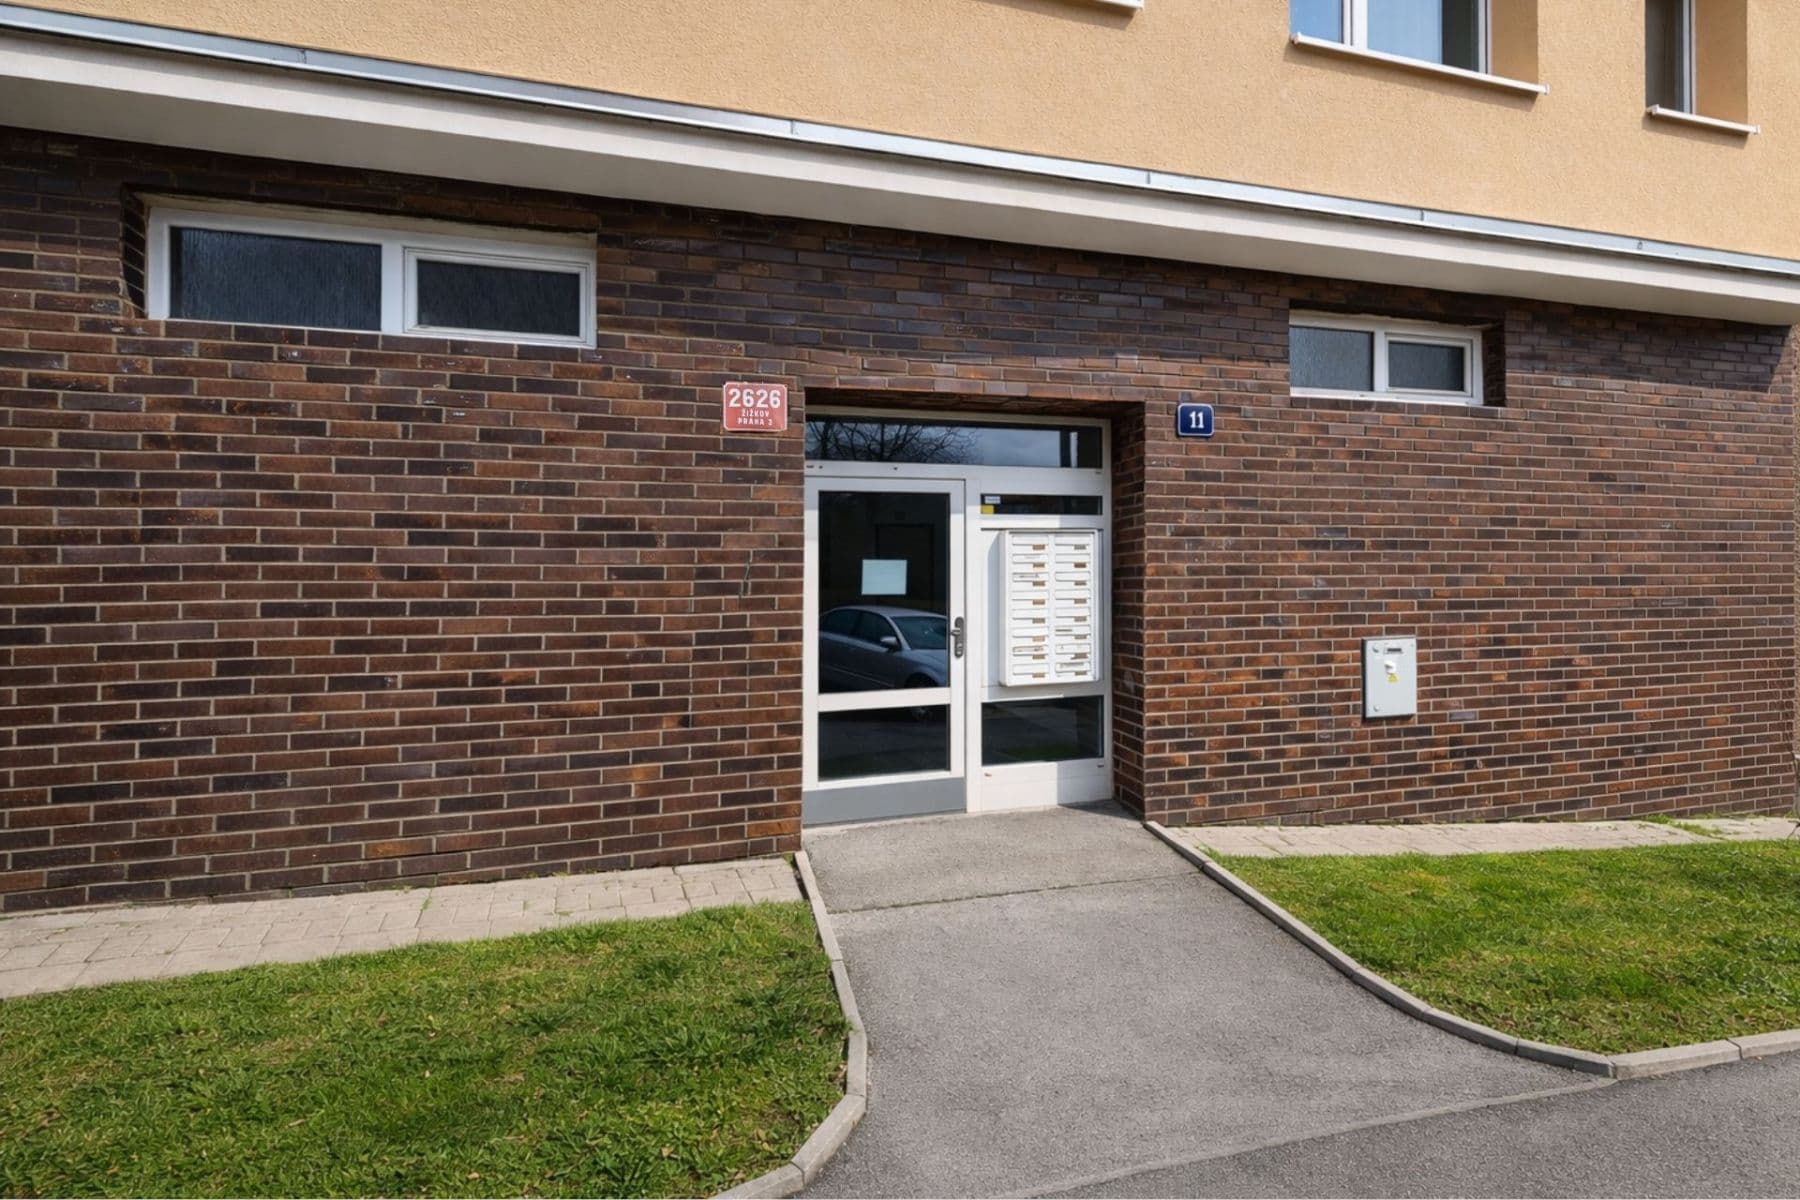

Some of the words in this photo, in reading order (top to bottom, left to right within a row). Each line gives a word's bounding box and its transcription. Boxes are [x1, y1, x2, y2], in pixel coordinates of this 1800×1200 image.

[728, 388, 781, 408] 2626
[741, 408, 769, 417] ŽIŽKOV
[1189, 410, 1205, 429] 11
[737, 417, 764, 425] PRAHA
[768, 418, 773, 426] 3
